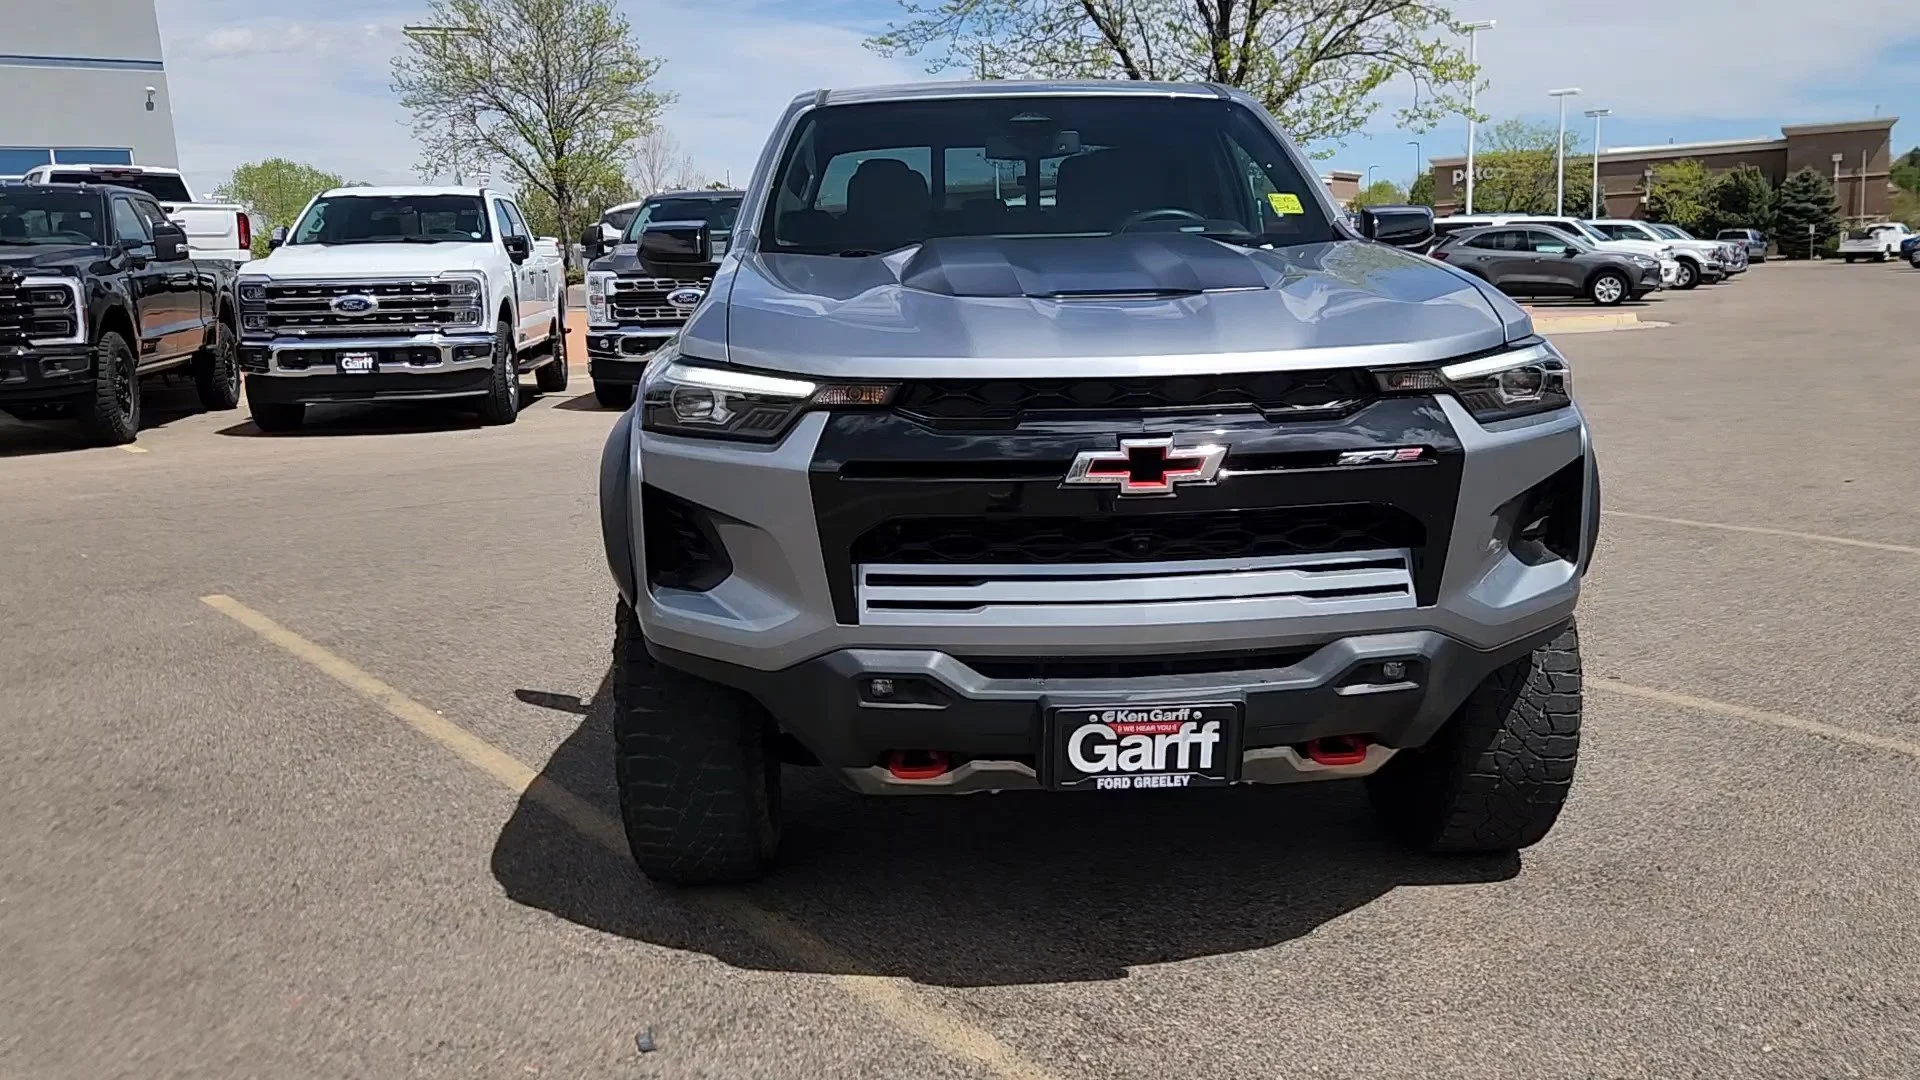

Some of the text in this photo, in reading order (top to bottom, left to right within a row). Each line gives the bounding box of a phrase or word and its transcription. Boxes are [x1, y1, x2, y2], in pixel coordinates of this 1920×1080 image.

[341, 357, 373, 370] Garff
[1116, 708, 1190, 722] Ken Garff
[1122, 723, 1172, 733] WE HEAR YOU
[1067, 720, 1220, 773] Garff
[1096, 775, 1190, 790] FORD GREELEY
